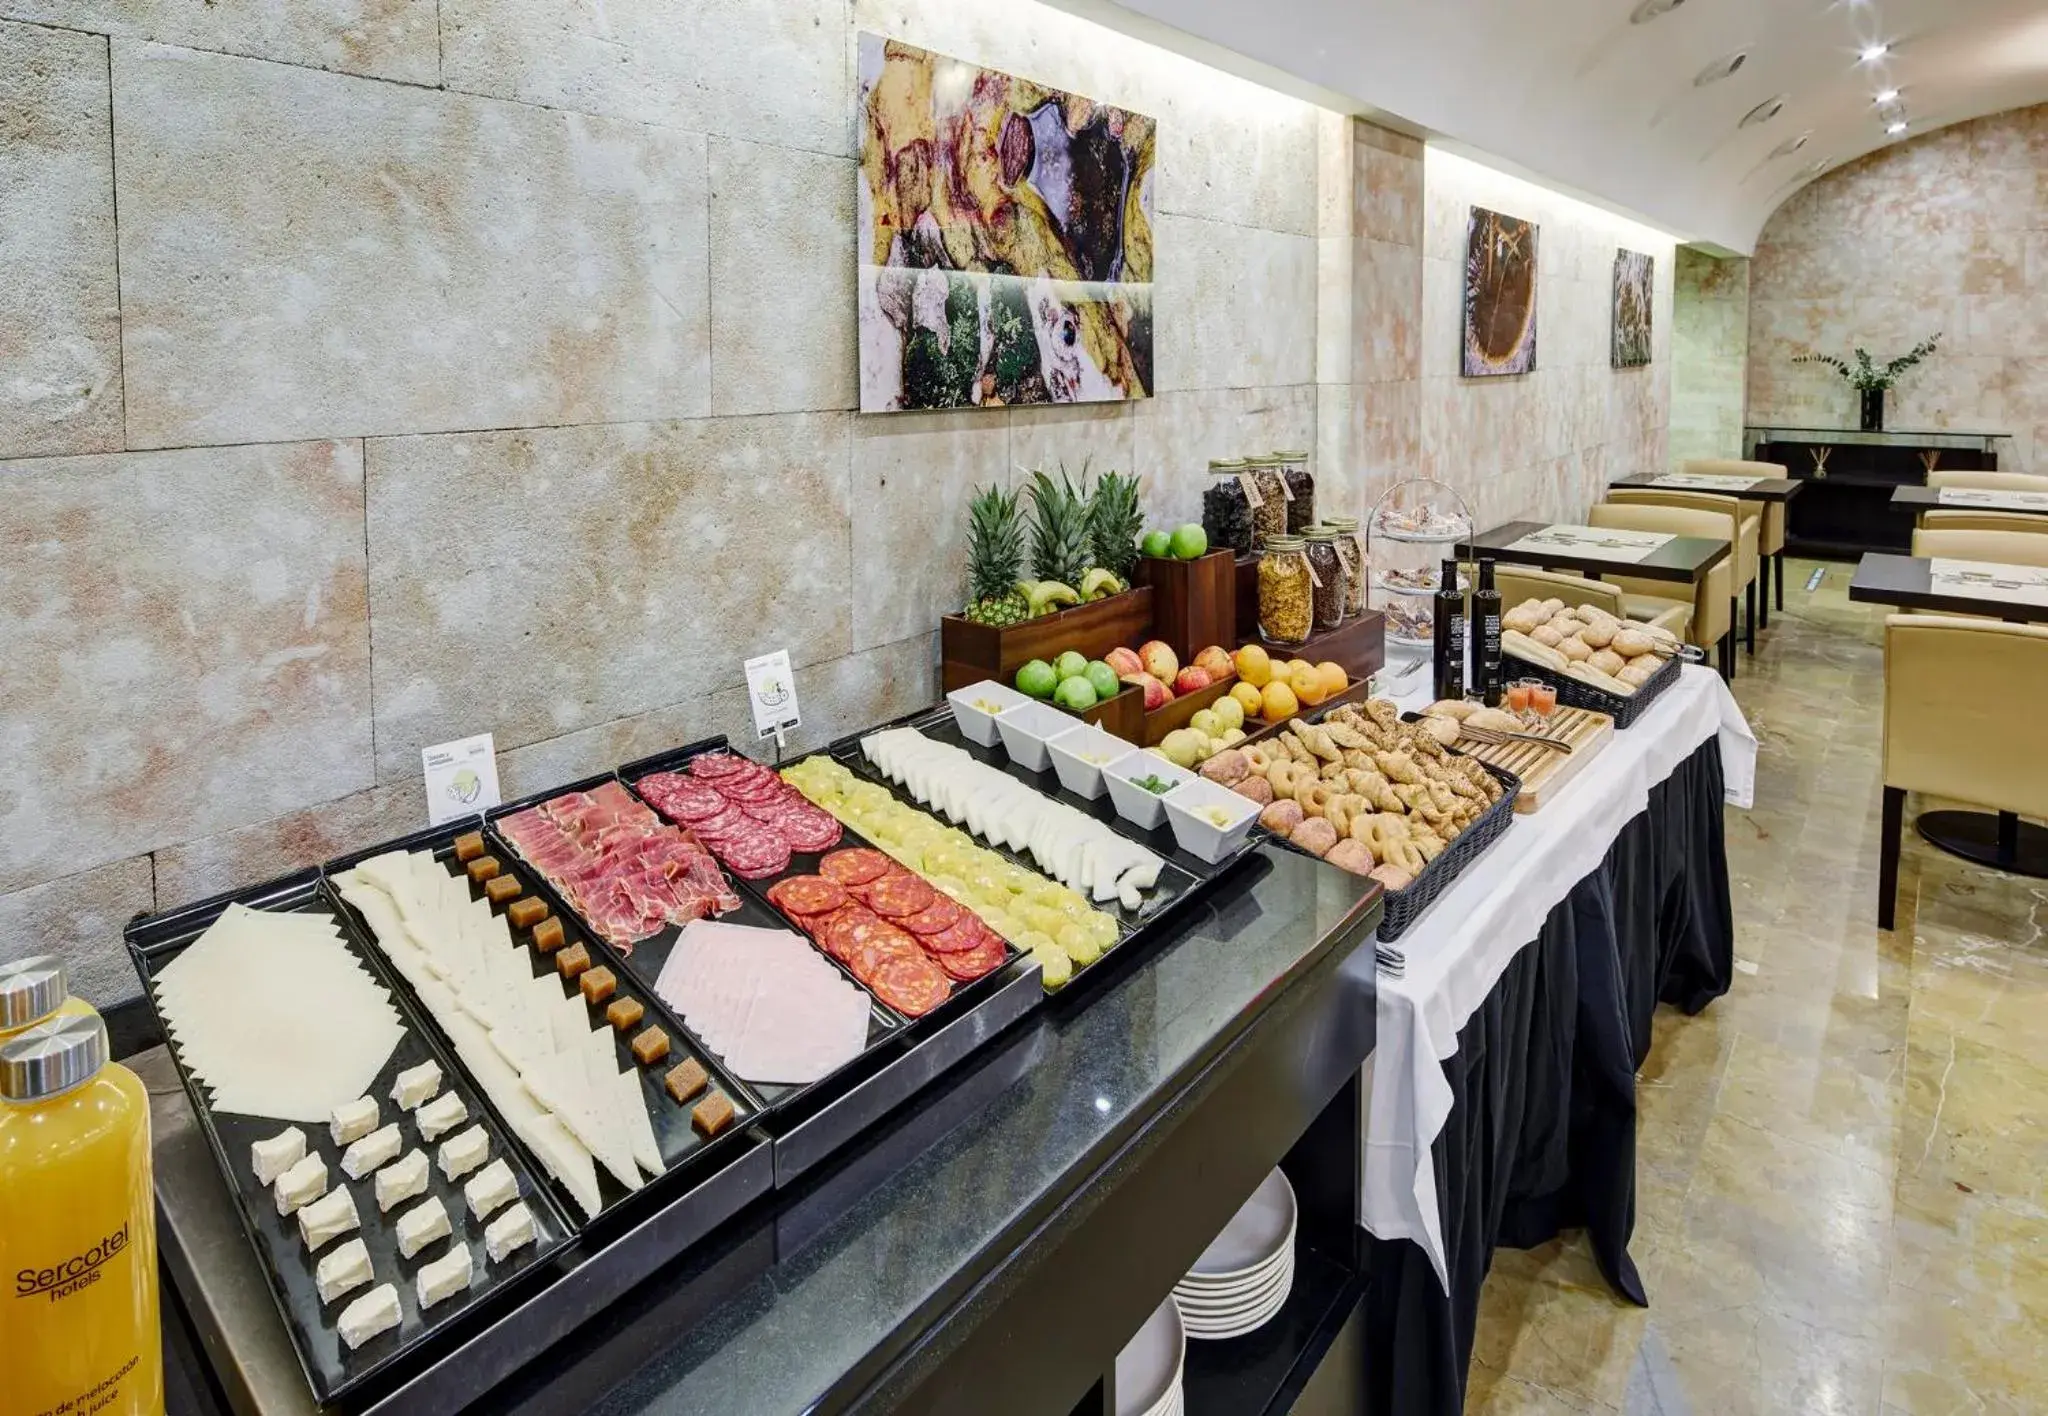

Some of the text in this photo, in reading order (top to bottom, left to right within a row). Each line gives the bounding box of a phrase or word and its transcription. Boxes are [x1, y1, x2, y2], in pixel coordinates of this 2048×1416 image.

[16, 1220, 129, 1293] Sercotel
[50, 1269, 101, 1303] hotels
[55, 1401, 74, 1416] de
[89, 1388, 119, 1416] juice
